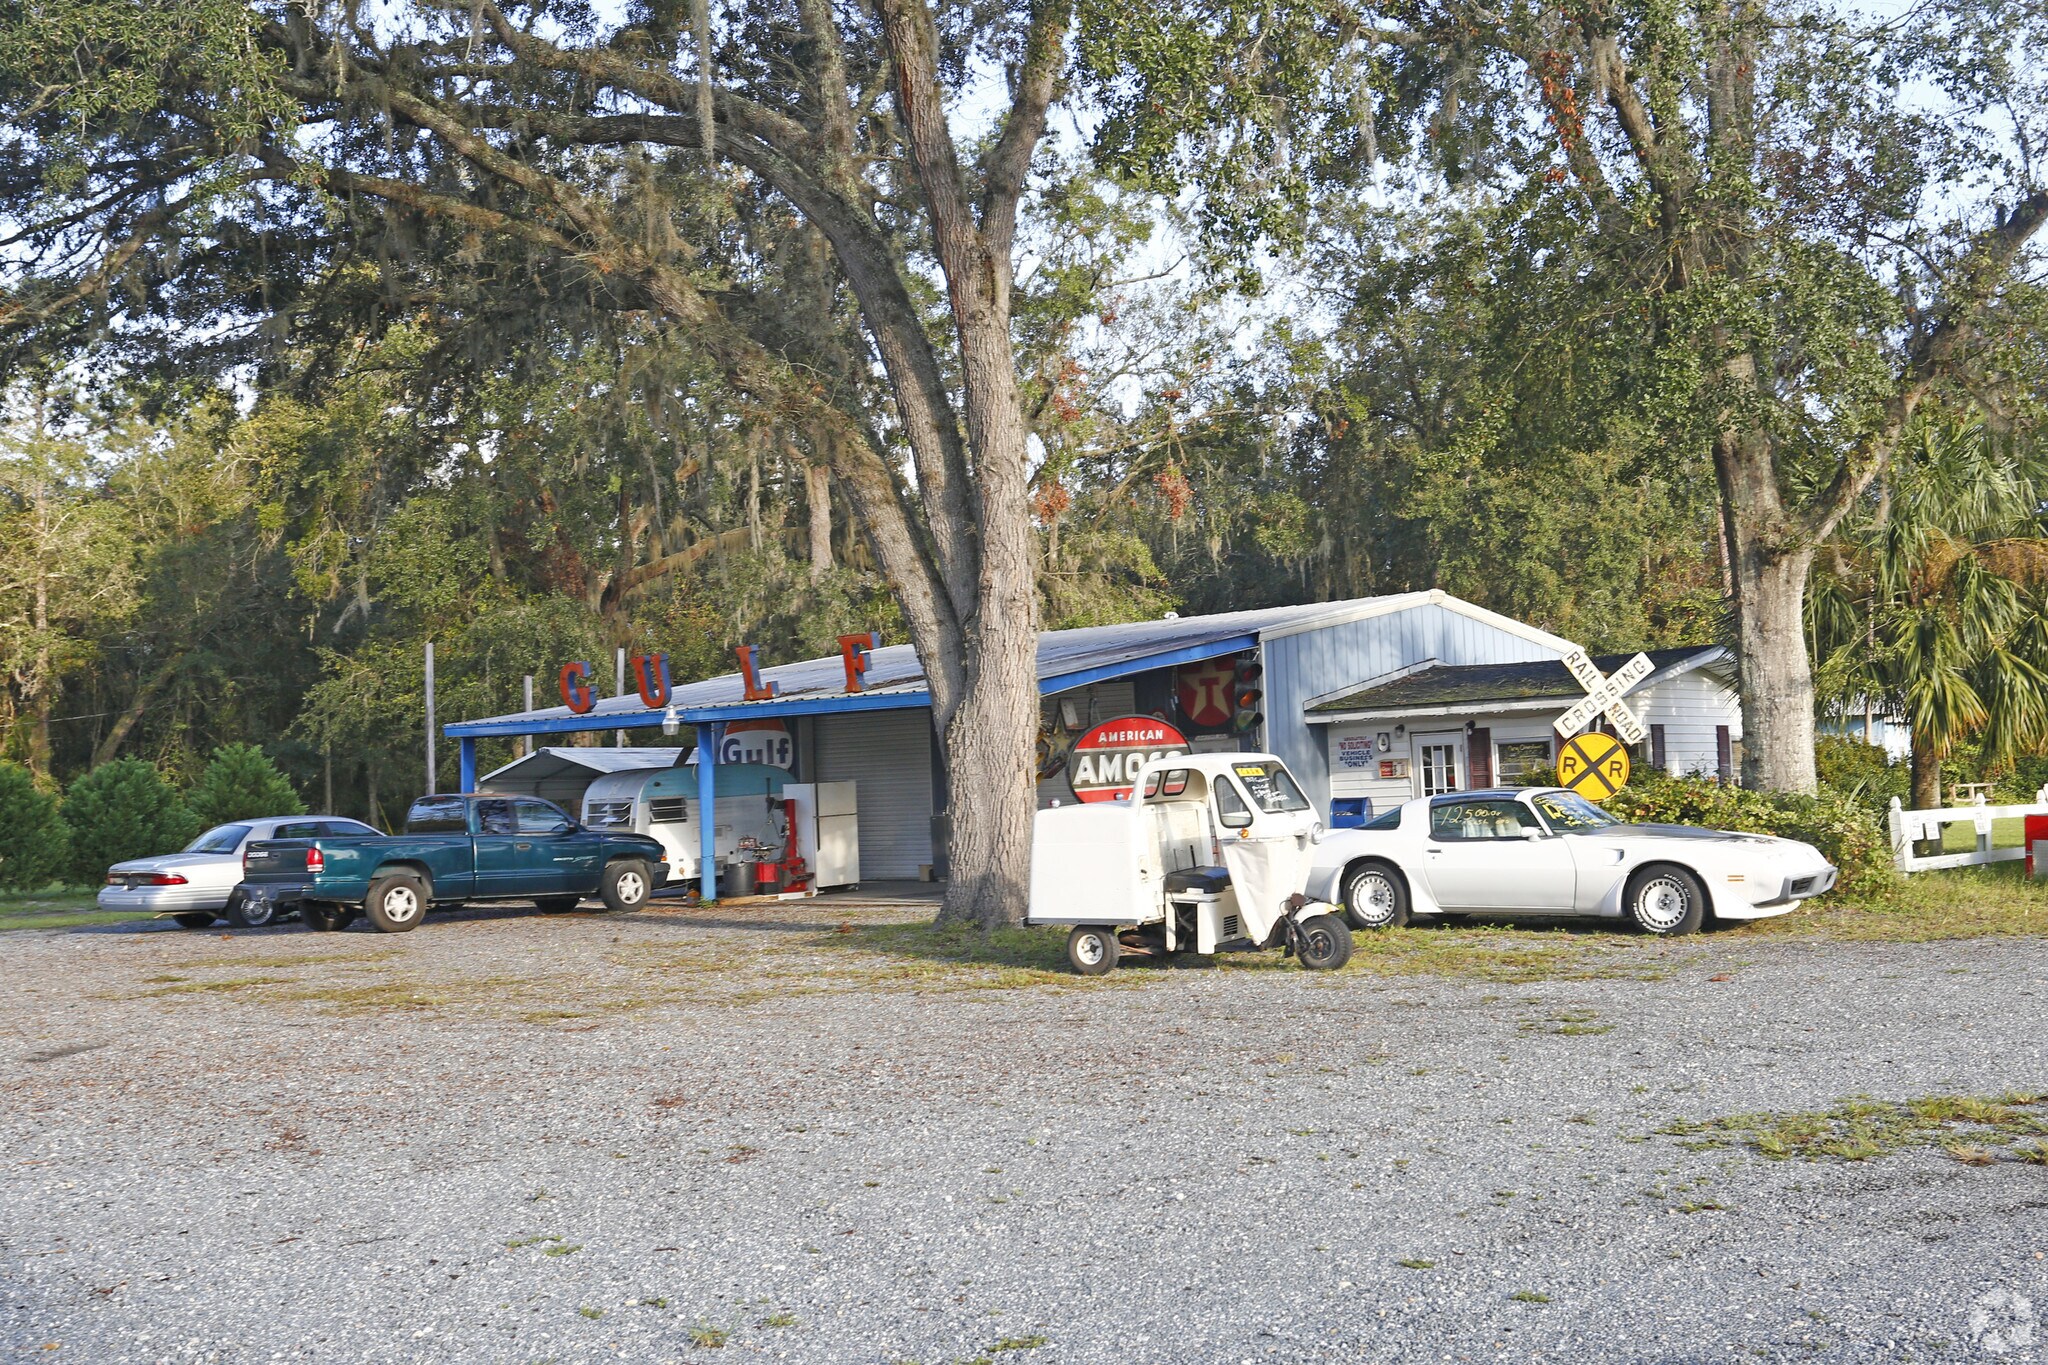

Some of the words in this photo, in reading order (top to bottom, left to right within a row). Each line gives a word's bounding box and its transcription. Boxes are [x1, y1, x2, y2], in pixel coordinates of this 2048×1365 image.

[559, 631, 879, 714] GULF
[1562, 660, 1646, 731] CROSSING
[1566, 651, 1597, 689] RAIL
[1607, 702, 1643, 742] ROAD
[722, 737, 789, 765] Gulf
[1098, 730, 1164, 742] AMERICAN
[1562, 756, 1577, 774] R
[1609, 760, 1623, 778] R
